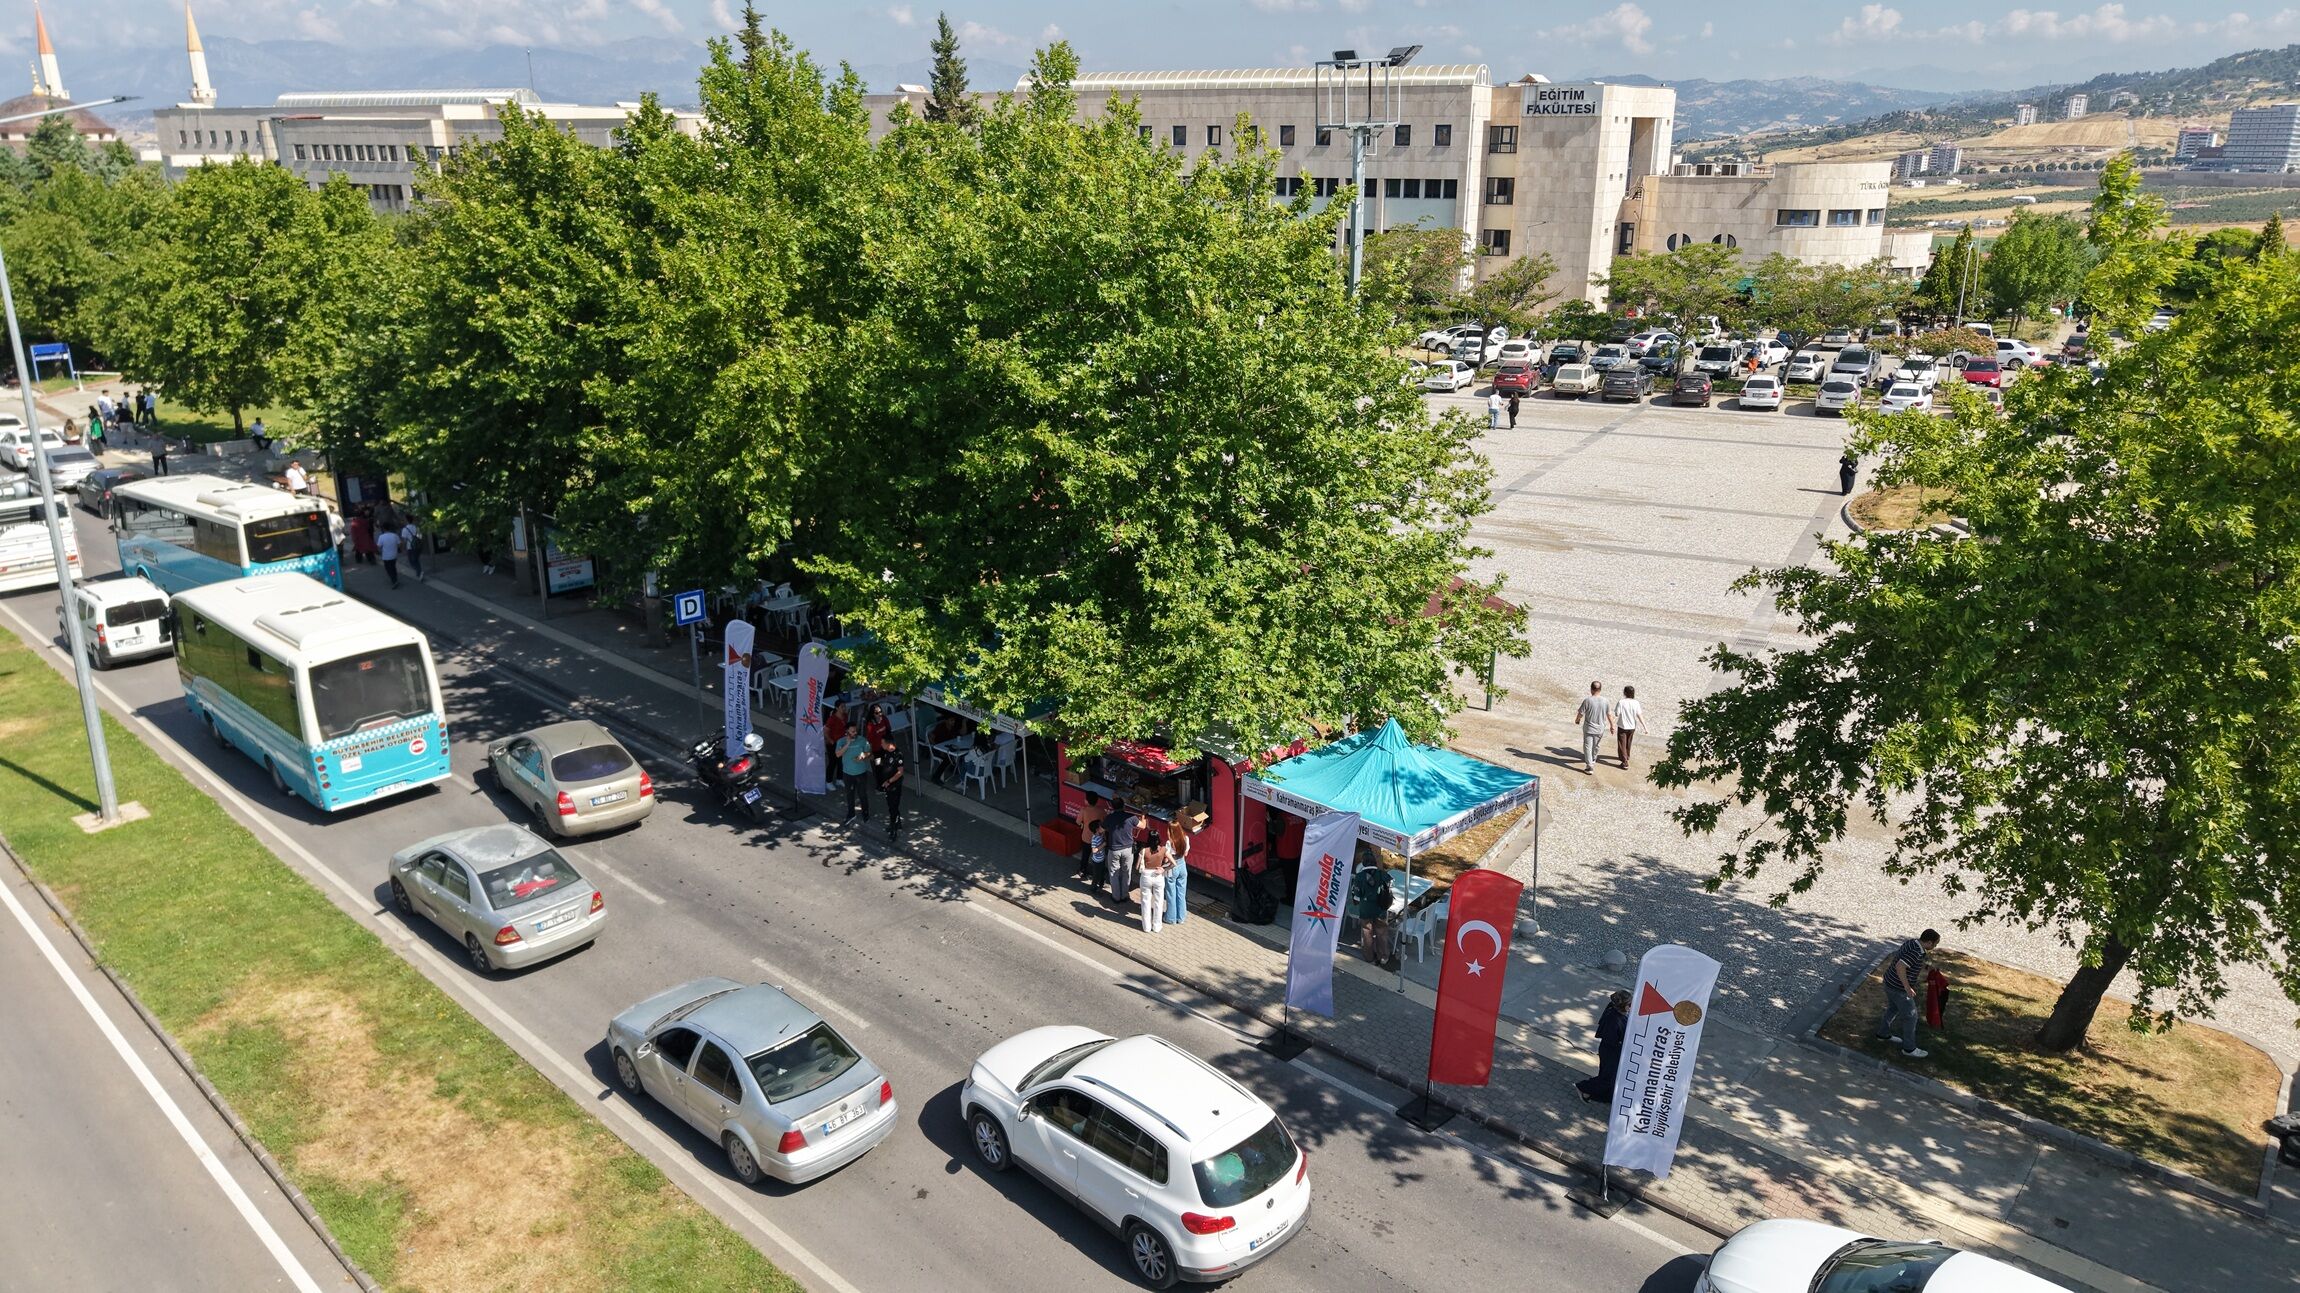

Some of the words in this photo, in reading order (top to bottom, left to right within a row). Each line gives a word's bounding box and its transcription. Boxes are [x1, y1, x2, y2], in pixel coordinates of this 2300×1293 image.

[1539, 88, 1584, 101] EĞİTİM
[1526, 101, 1596, 114] FAKÜLTESİ
[685, 599, 698, 616] D
[364, 744, 385, 754] HALK
[1316, 853, 1335, 912] pusula
[1328, 858, 1345, 907] maraş
[1633, 1026, 1671, 1134] Kahramanmaraş
[1652, 1083, 1674, 1138] Büyükşehir
[1663, 1030, 1686, 1082] Belediyesi
[829, 1120, 837, 1129] 46
